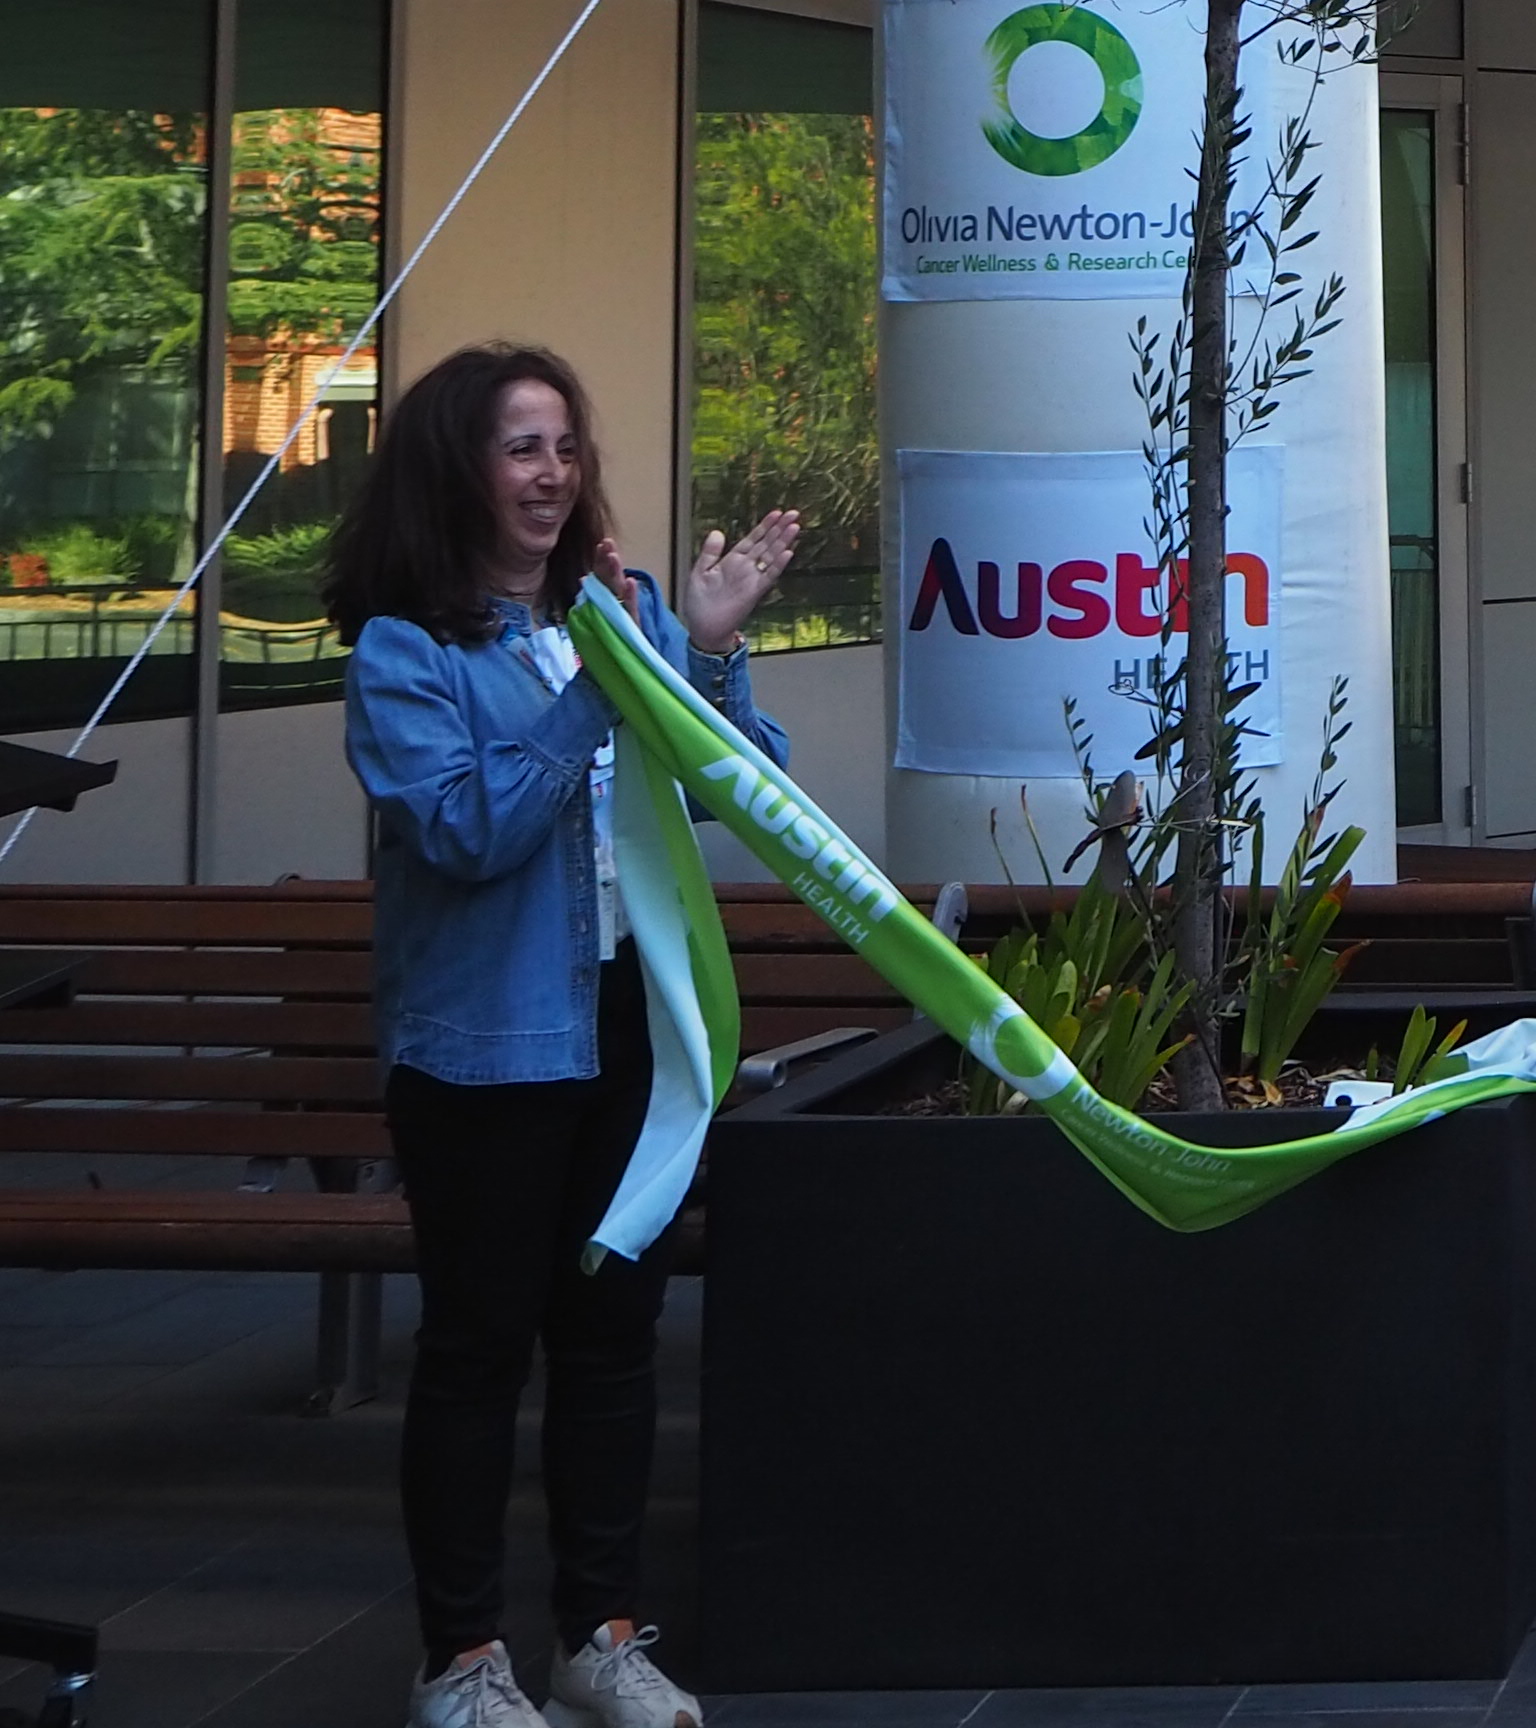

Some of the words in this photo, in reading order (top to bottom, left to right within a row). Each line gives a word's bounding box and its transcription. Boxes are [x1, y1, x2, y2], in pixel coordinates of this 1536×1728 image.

[902, 206, 978, 244] Olivia
[987, 201, 1252, 242] Newton-Jon
[917, 255, 961, 274] Cancer
[962, 253, 1037, 273] Wellness
[1044, 253, 1060, 271] &
[1068, 251, 1157, 271] Research
[1114, 648, 1269, 690] HETH
[700, 754, 899, 923] Austin
[793, 871, 870, 944] HEALTH
